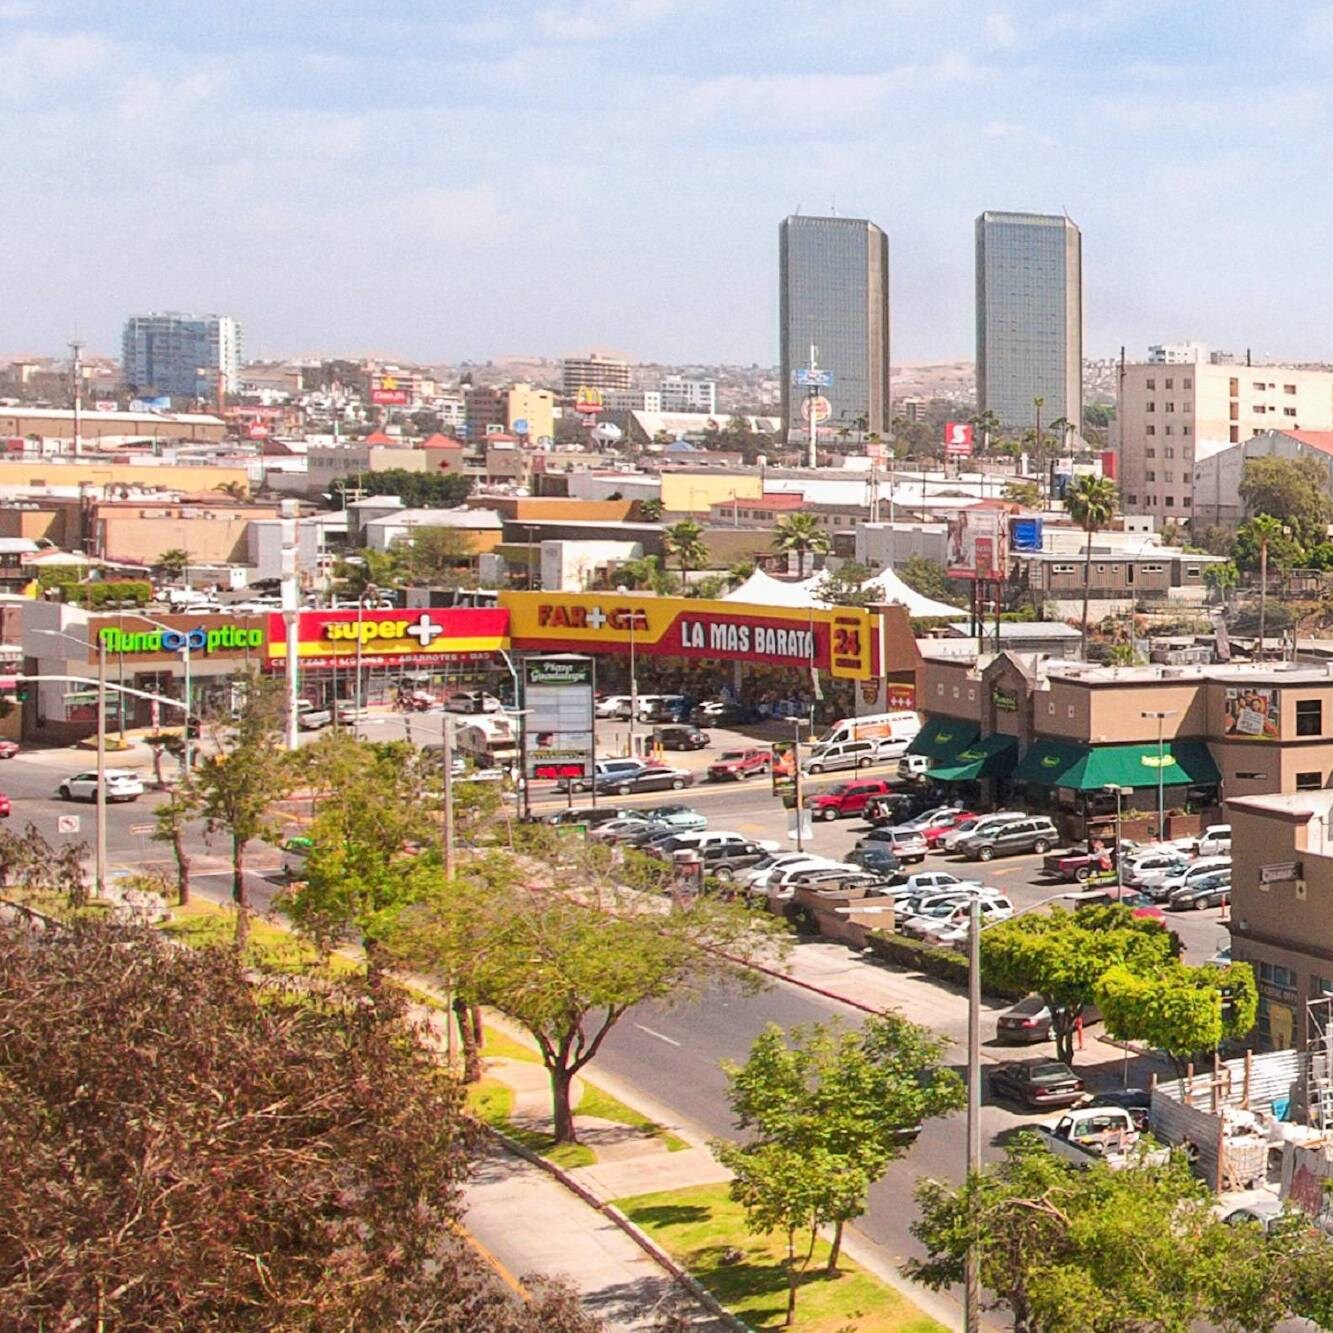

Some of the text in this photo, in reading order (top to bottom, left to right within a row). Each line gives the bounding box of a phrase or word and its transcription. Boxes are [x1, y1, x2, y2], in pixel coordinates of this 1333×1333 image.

[681, 620, 814, 659] LA MAS BARATA
[833, 628, 862, 656] 24
